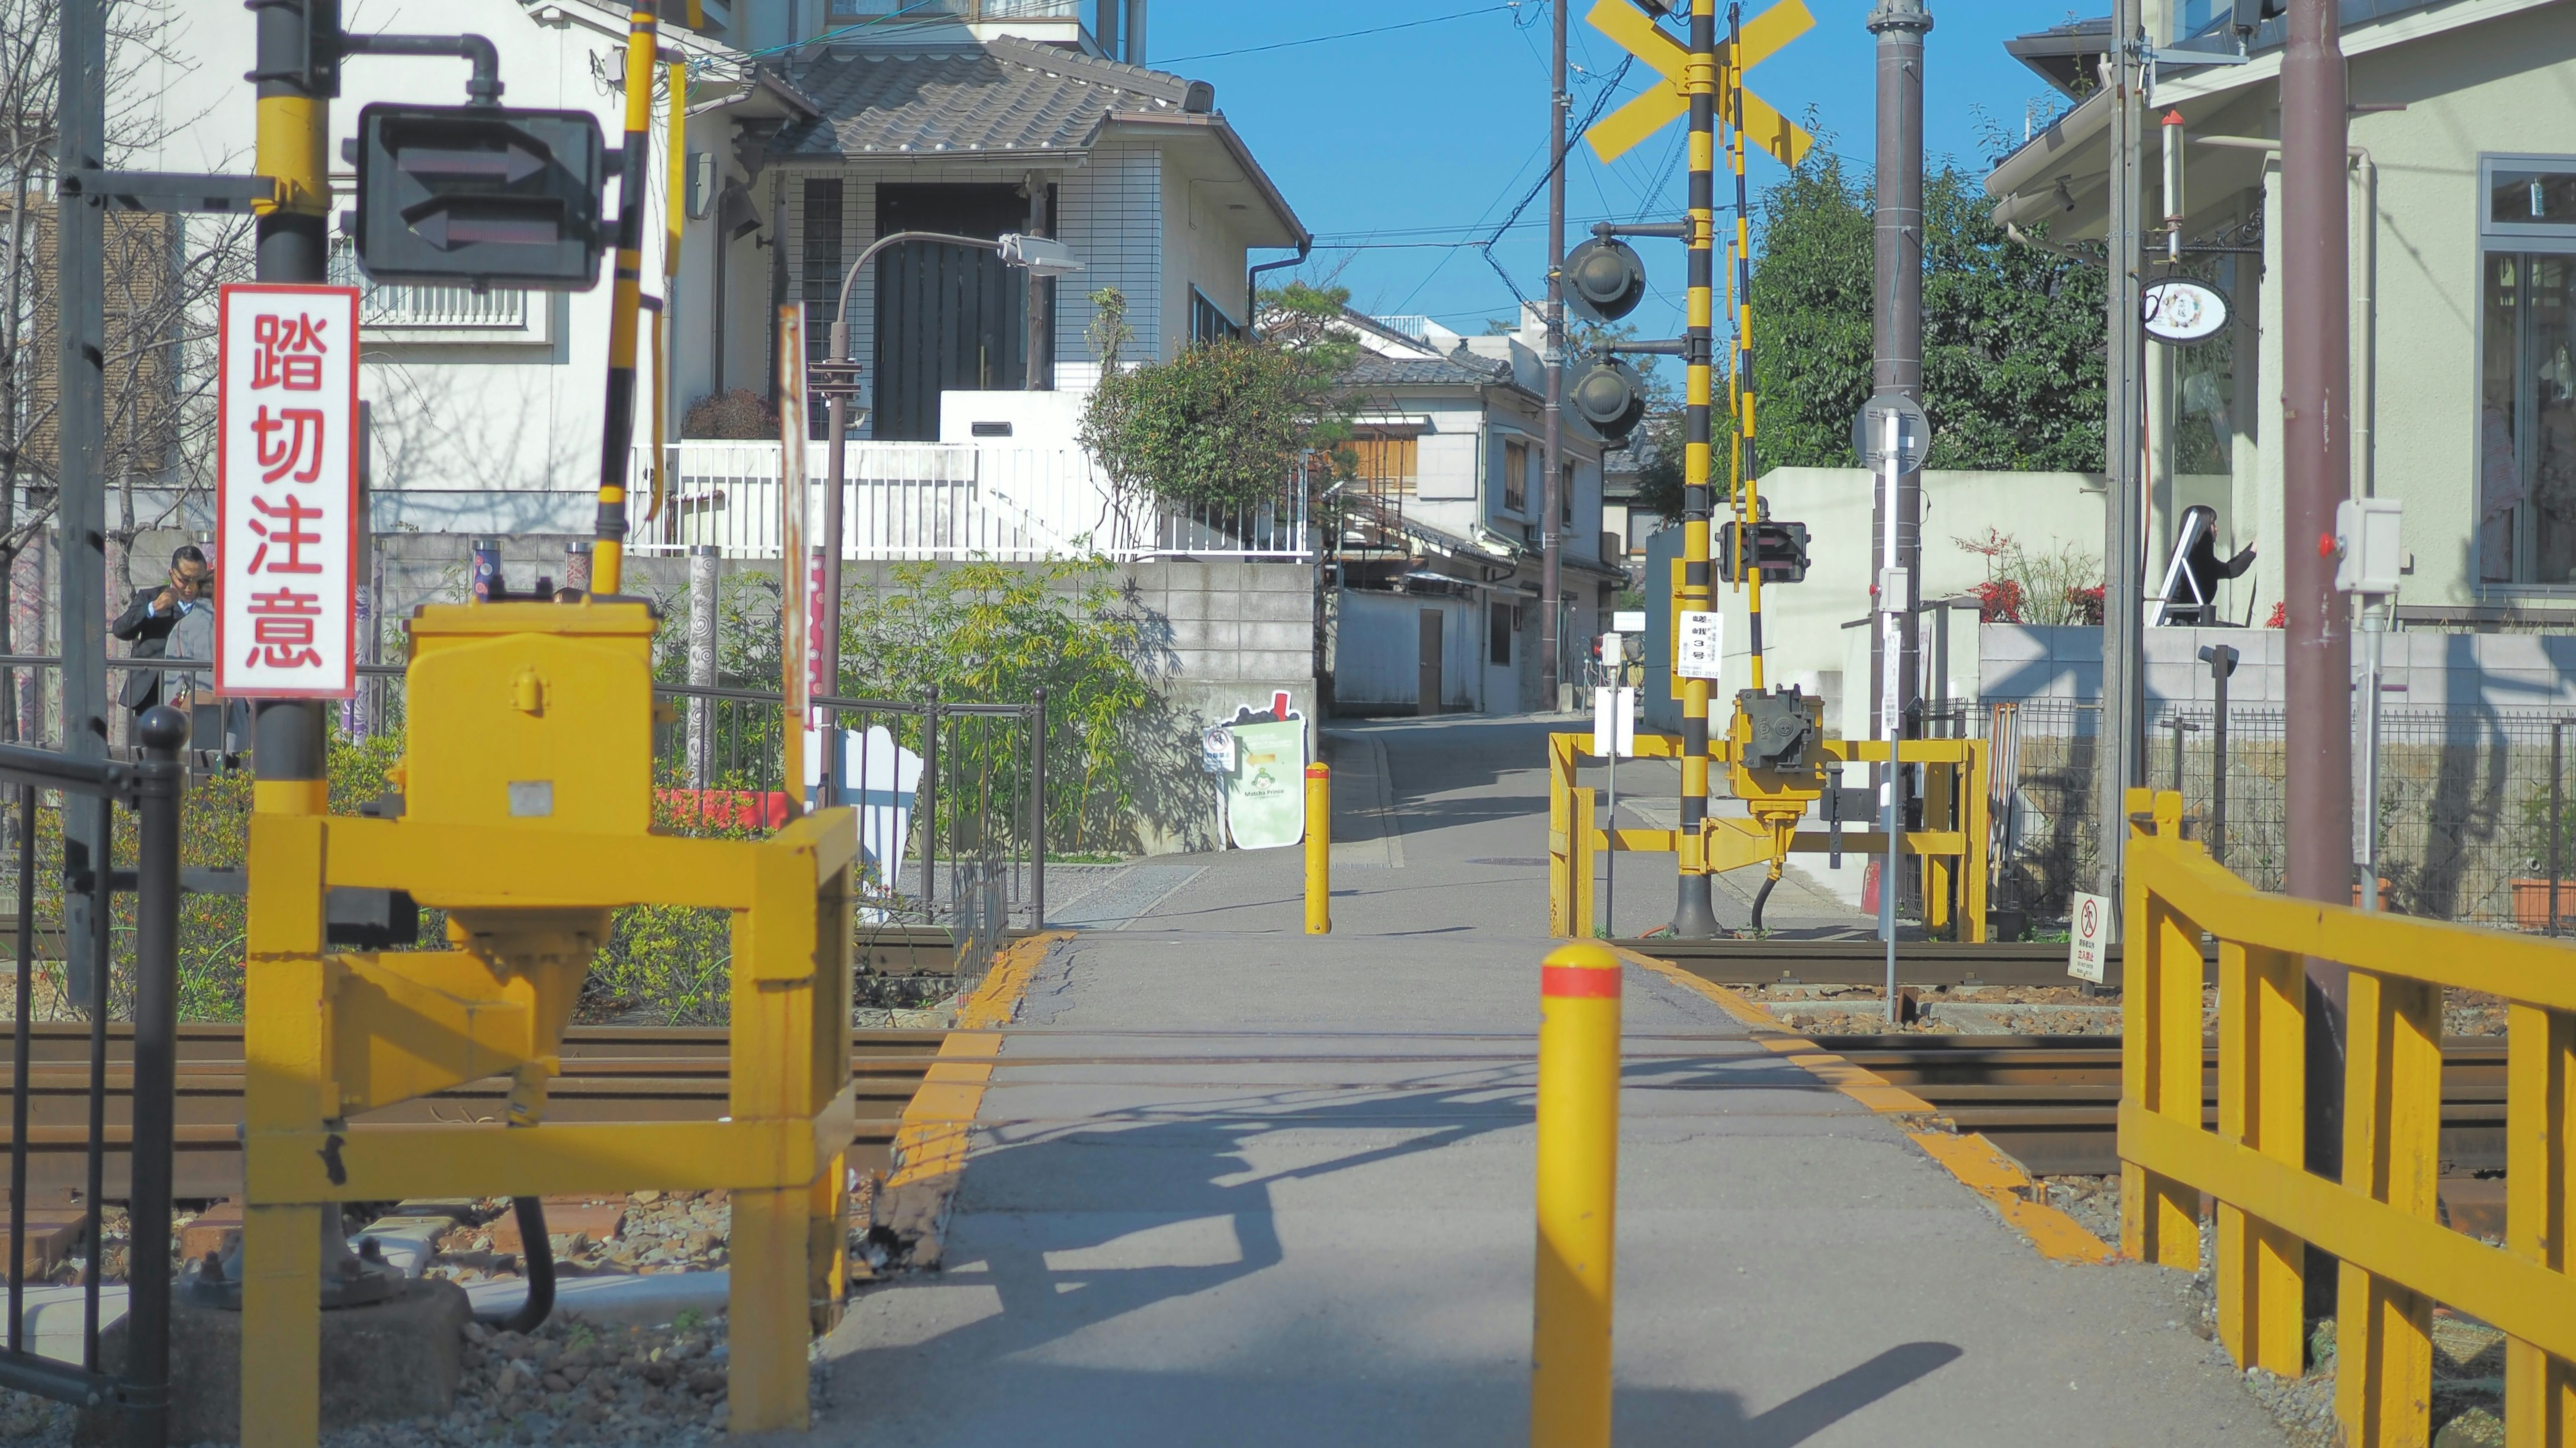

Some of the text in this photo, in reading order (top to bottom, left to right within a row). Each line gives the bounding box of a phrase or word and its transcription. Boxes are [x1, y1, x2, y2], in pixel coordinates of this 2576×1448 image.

[246, 312, 327, 670] 踏切注意
[2078, 950, 2094, 961] 立入禁止
